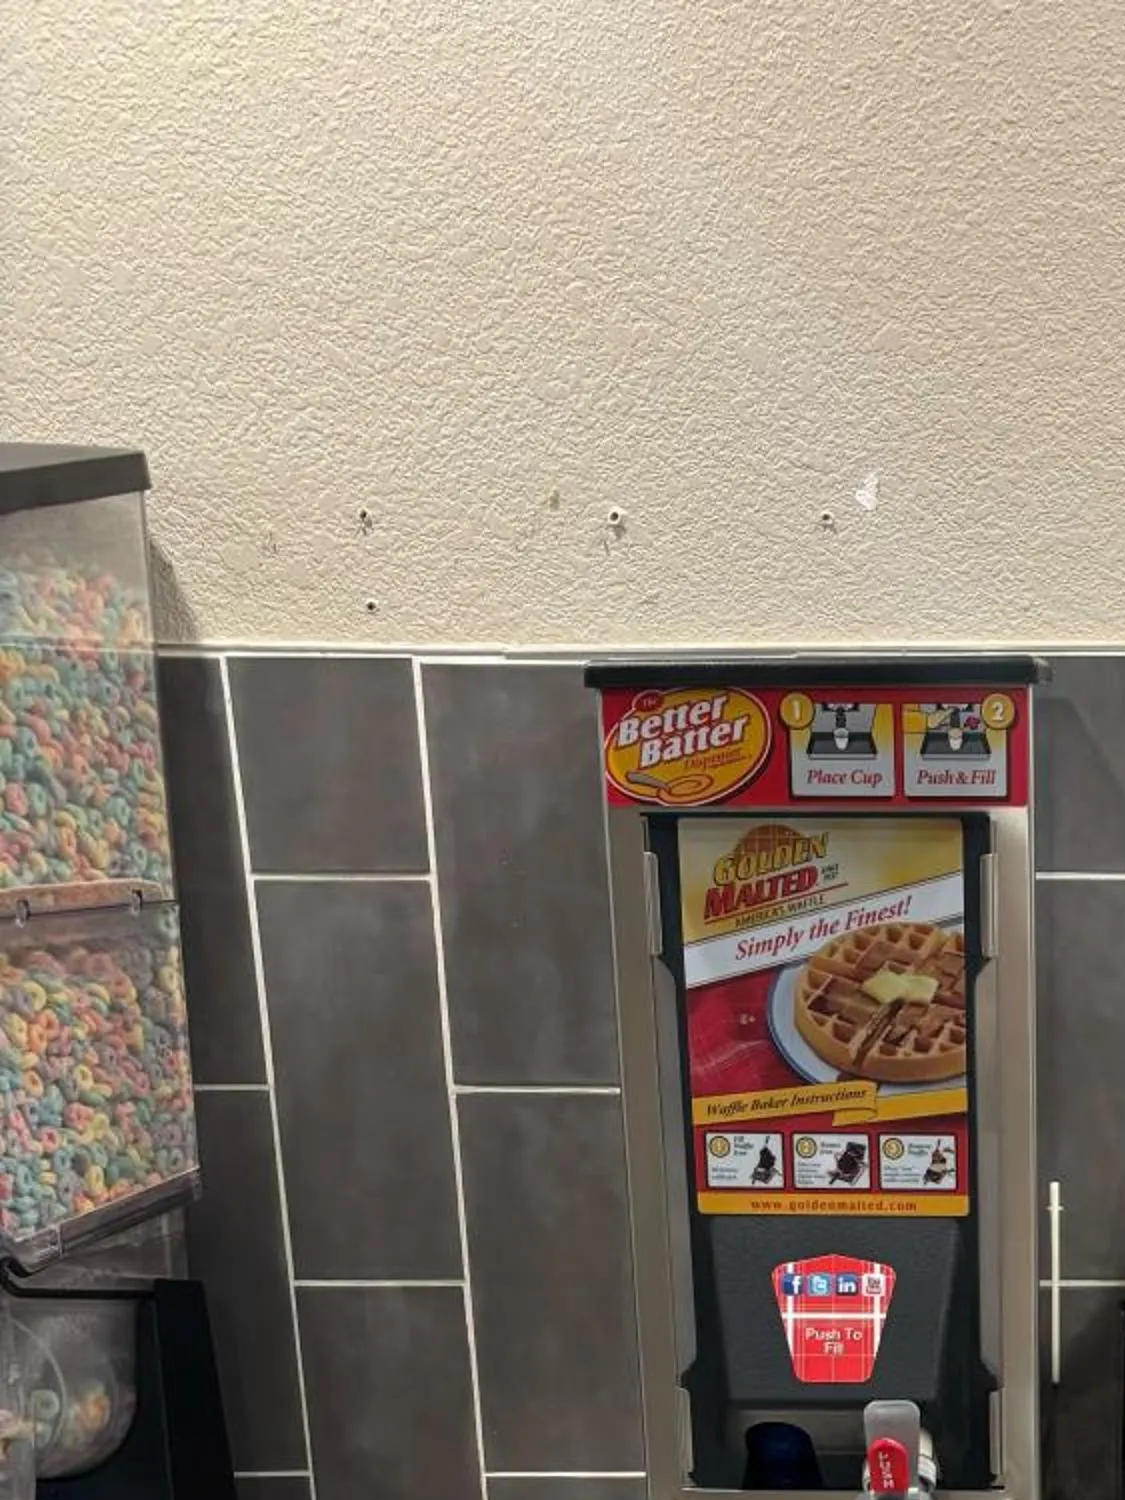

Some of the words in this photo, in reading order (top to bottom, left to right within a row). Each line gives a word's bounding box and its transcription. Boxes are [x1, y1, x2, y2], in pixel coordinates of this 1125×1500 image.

[618, 695, 728, 747] Better
[792, 700, 800, 721] 1
[991, 701, 1004, 720] 2
[640, 716, 749, 768] Batter
[807, 769, 847, 785] Place
[851, 769, 883, 788] Cup
[713, 831, 830, 886] GOLDEN
[704, 865, 819, 920] MALTED
[736, 926, 804, 960] Simply
[809, 917, 841, 941] the
[844, 895, 913, 931] Finest!
[706, 1102, 749, 1117] Waffle
[750, 1096, 788, 1112] Baker
[790, 1088, 868, 1108] Instructions
[751, 1200, 917, 1213] www.goldenmalted.com
[805, 1327, 840, 1341] Push
[844, 1327, 863, 1340] To
[824, 1341, 845, 1355] Fill
